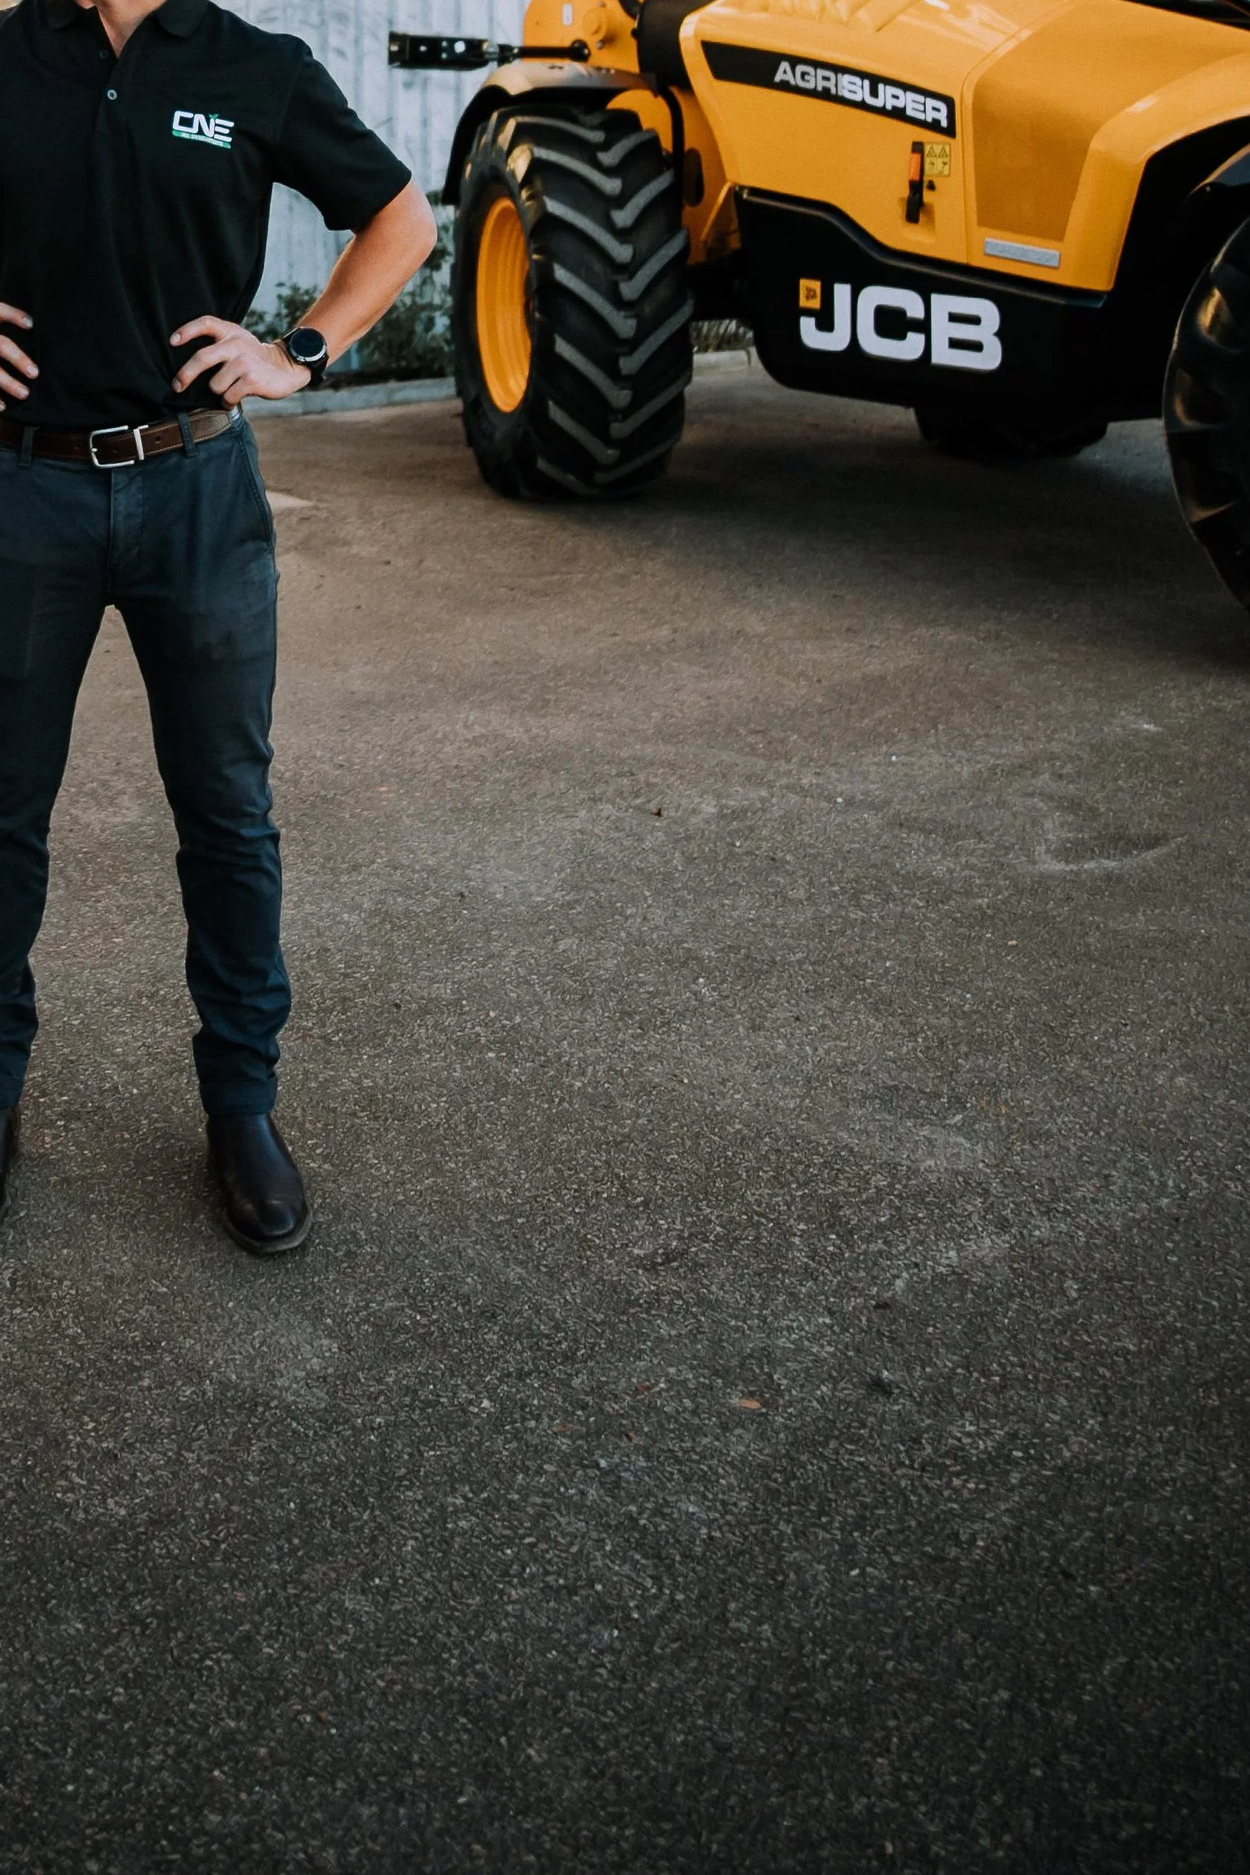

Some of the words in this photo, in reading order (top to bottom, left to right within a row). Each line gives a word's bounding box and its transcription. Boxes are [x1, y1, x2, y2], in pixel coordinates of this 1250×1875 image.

[173, 110, 234, 142] CNE
[774, 61, 948, 128] AGRISUPER
[800, 282, 1002, 371] JCB
